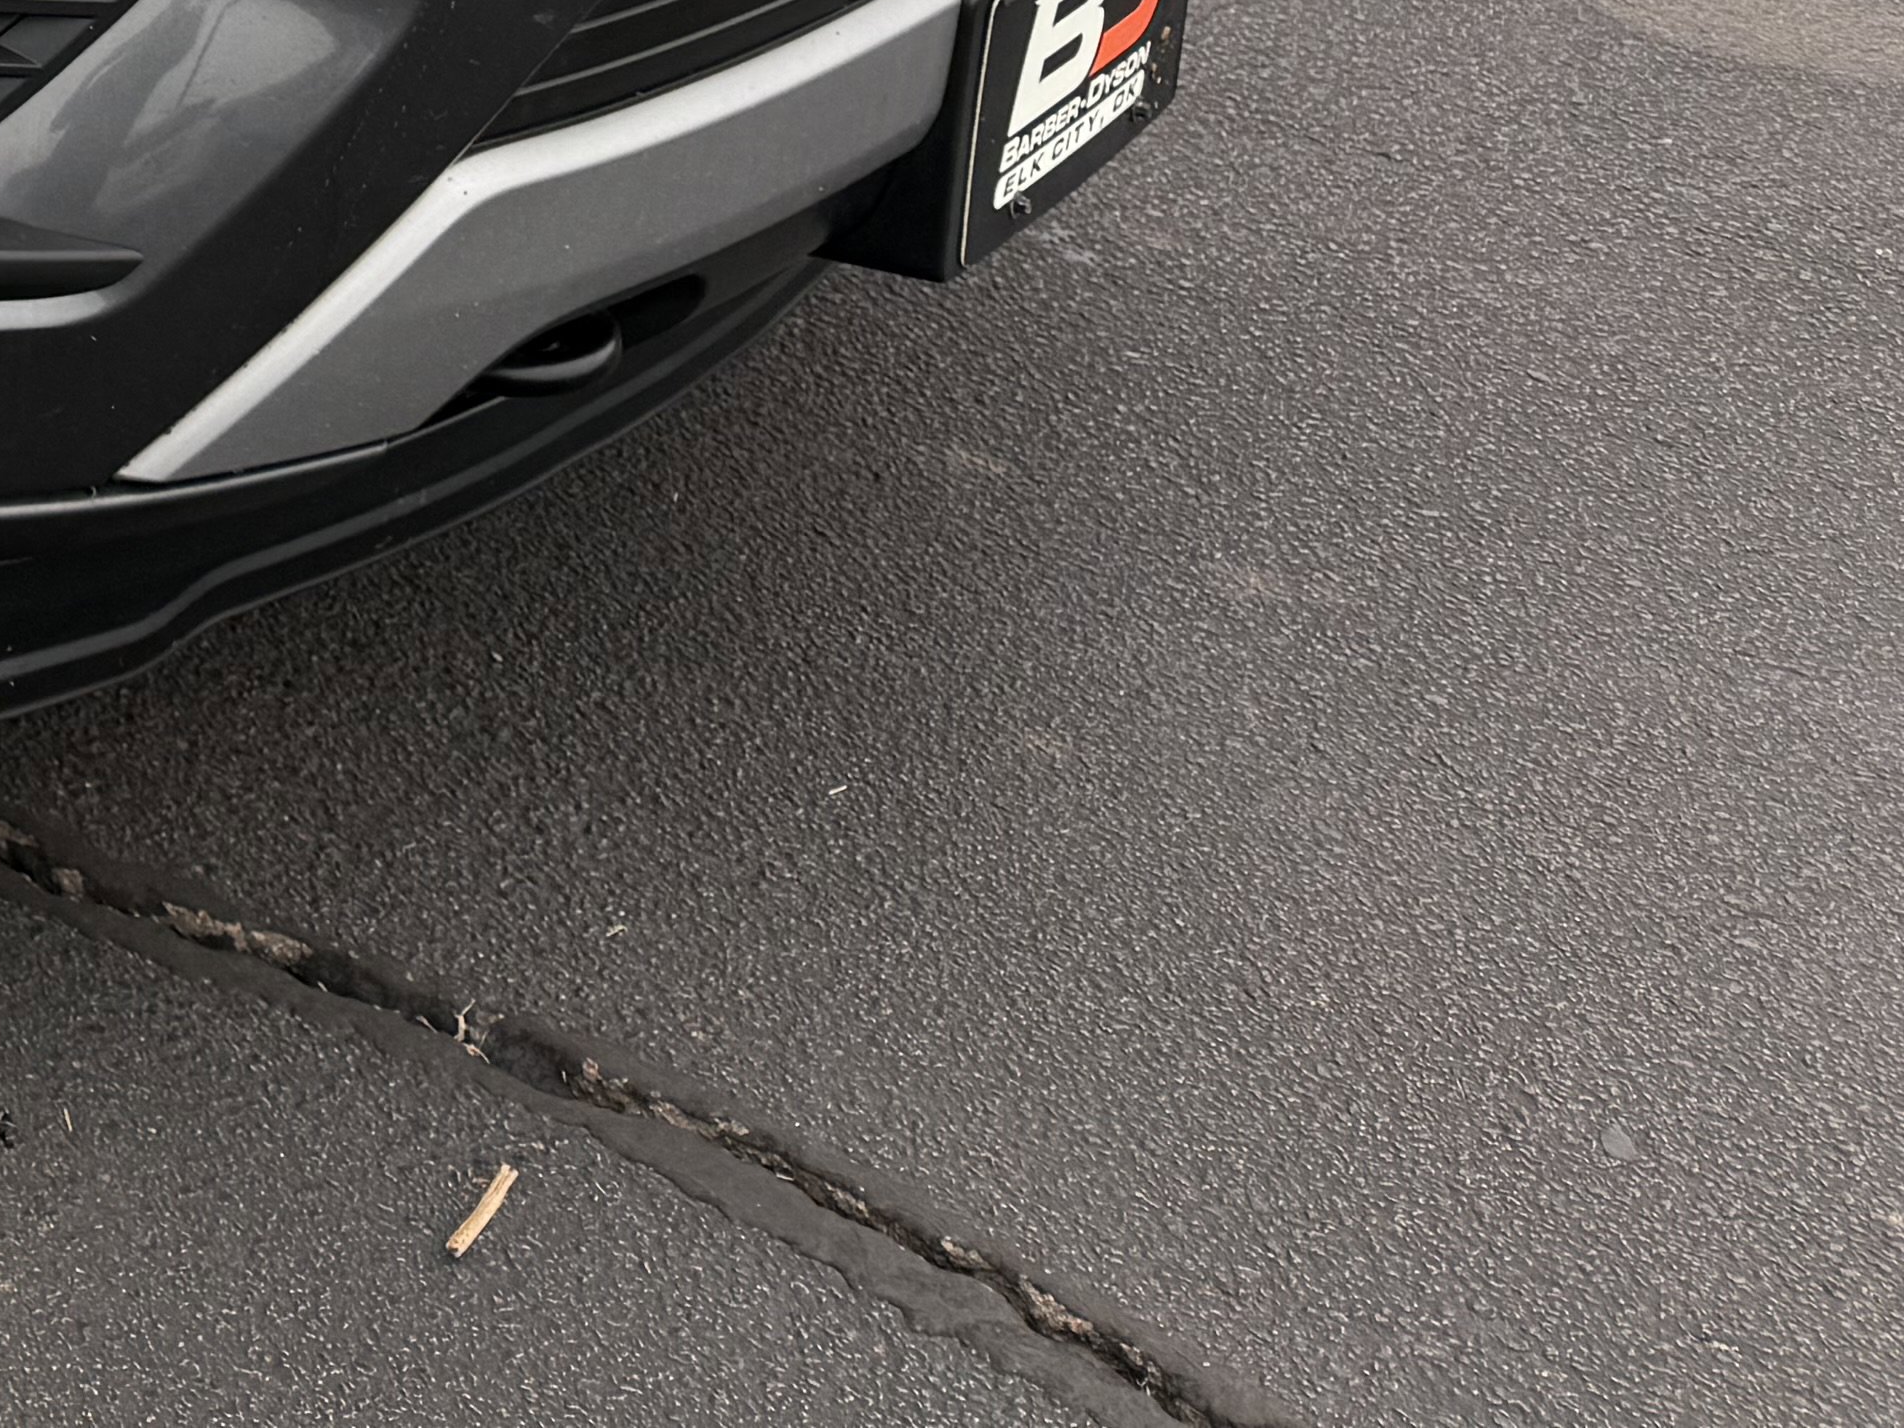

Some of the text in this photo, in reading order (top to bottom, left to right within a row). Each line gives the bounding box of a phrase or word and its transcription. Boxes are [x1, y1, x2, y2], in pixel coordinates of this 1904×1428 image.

[1003, 77, 1139, 198] ELK CITY, OK
